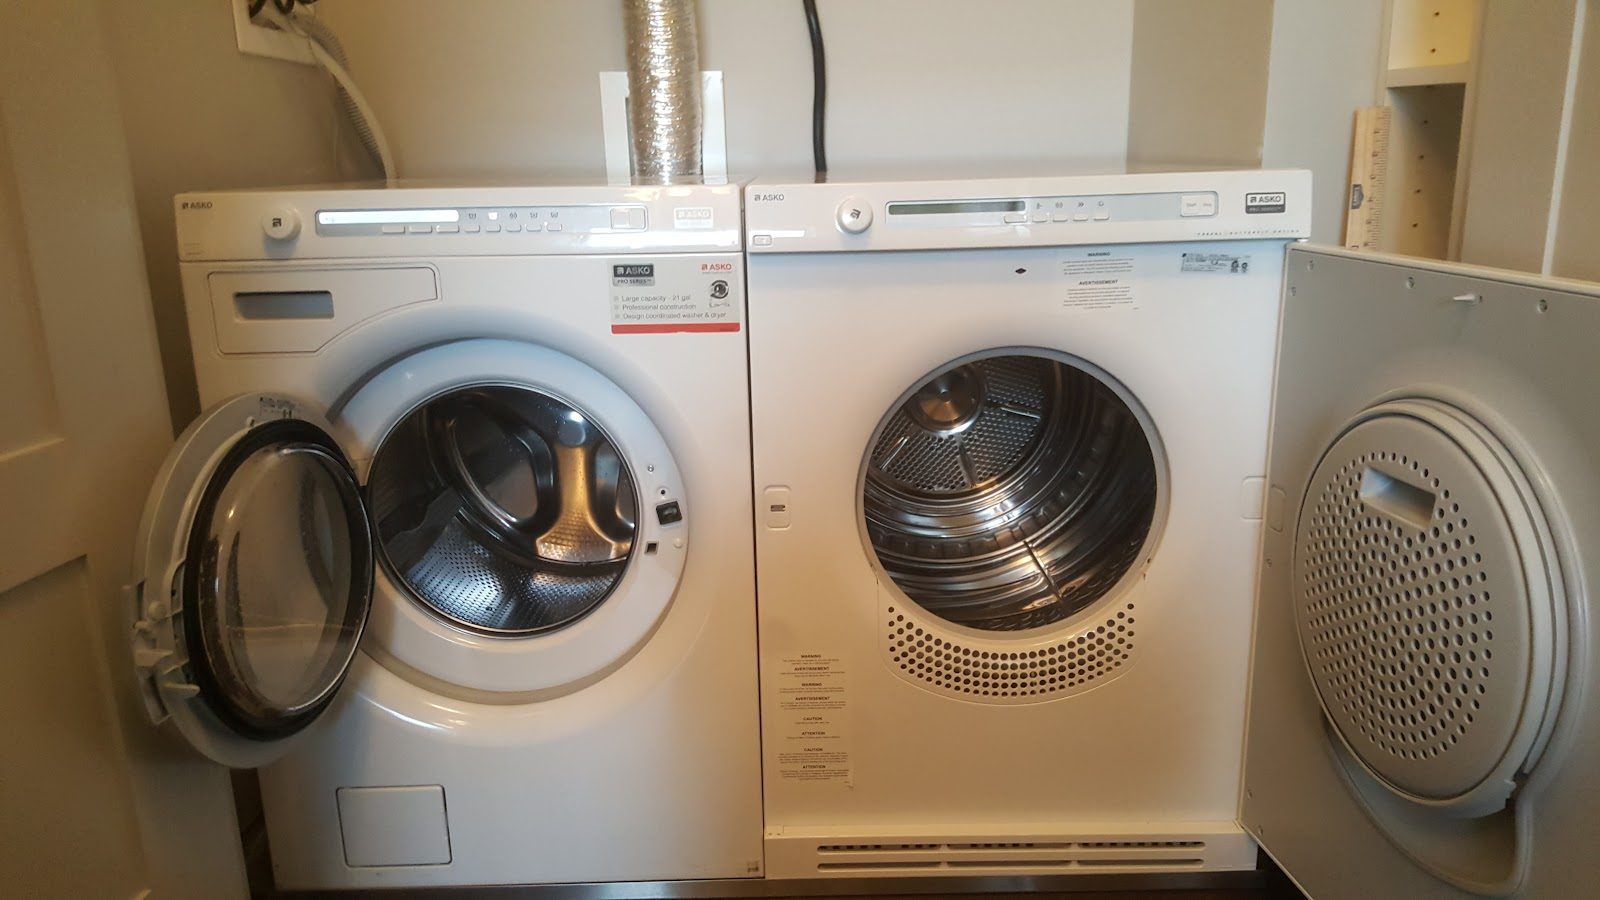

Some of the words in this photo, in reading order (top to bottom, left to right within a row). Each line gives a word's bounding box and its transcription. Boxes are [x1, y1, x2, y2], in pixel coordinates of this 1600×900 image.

[190, 201, 213, 209] ASKO
[626, 266, 650, 275] ASKO
[709, 263, 732, 271] ASKO
